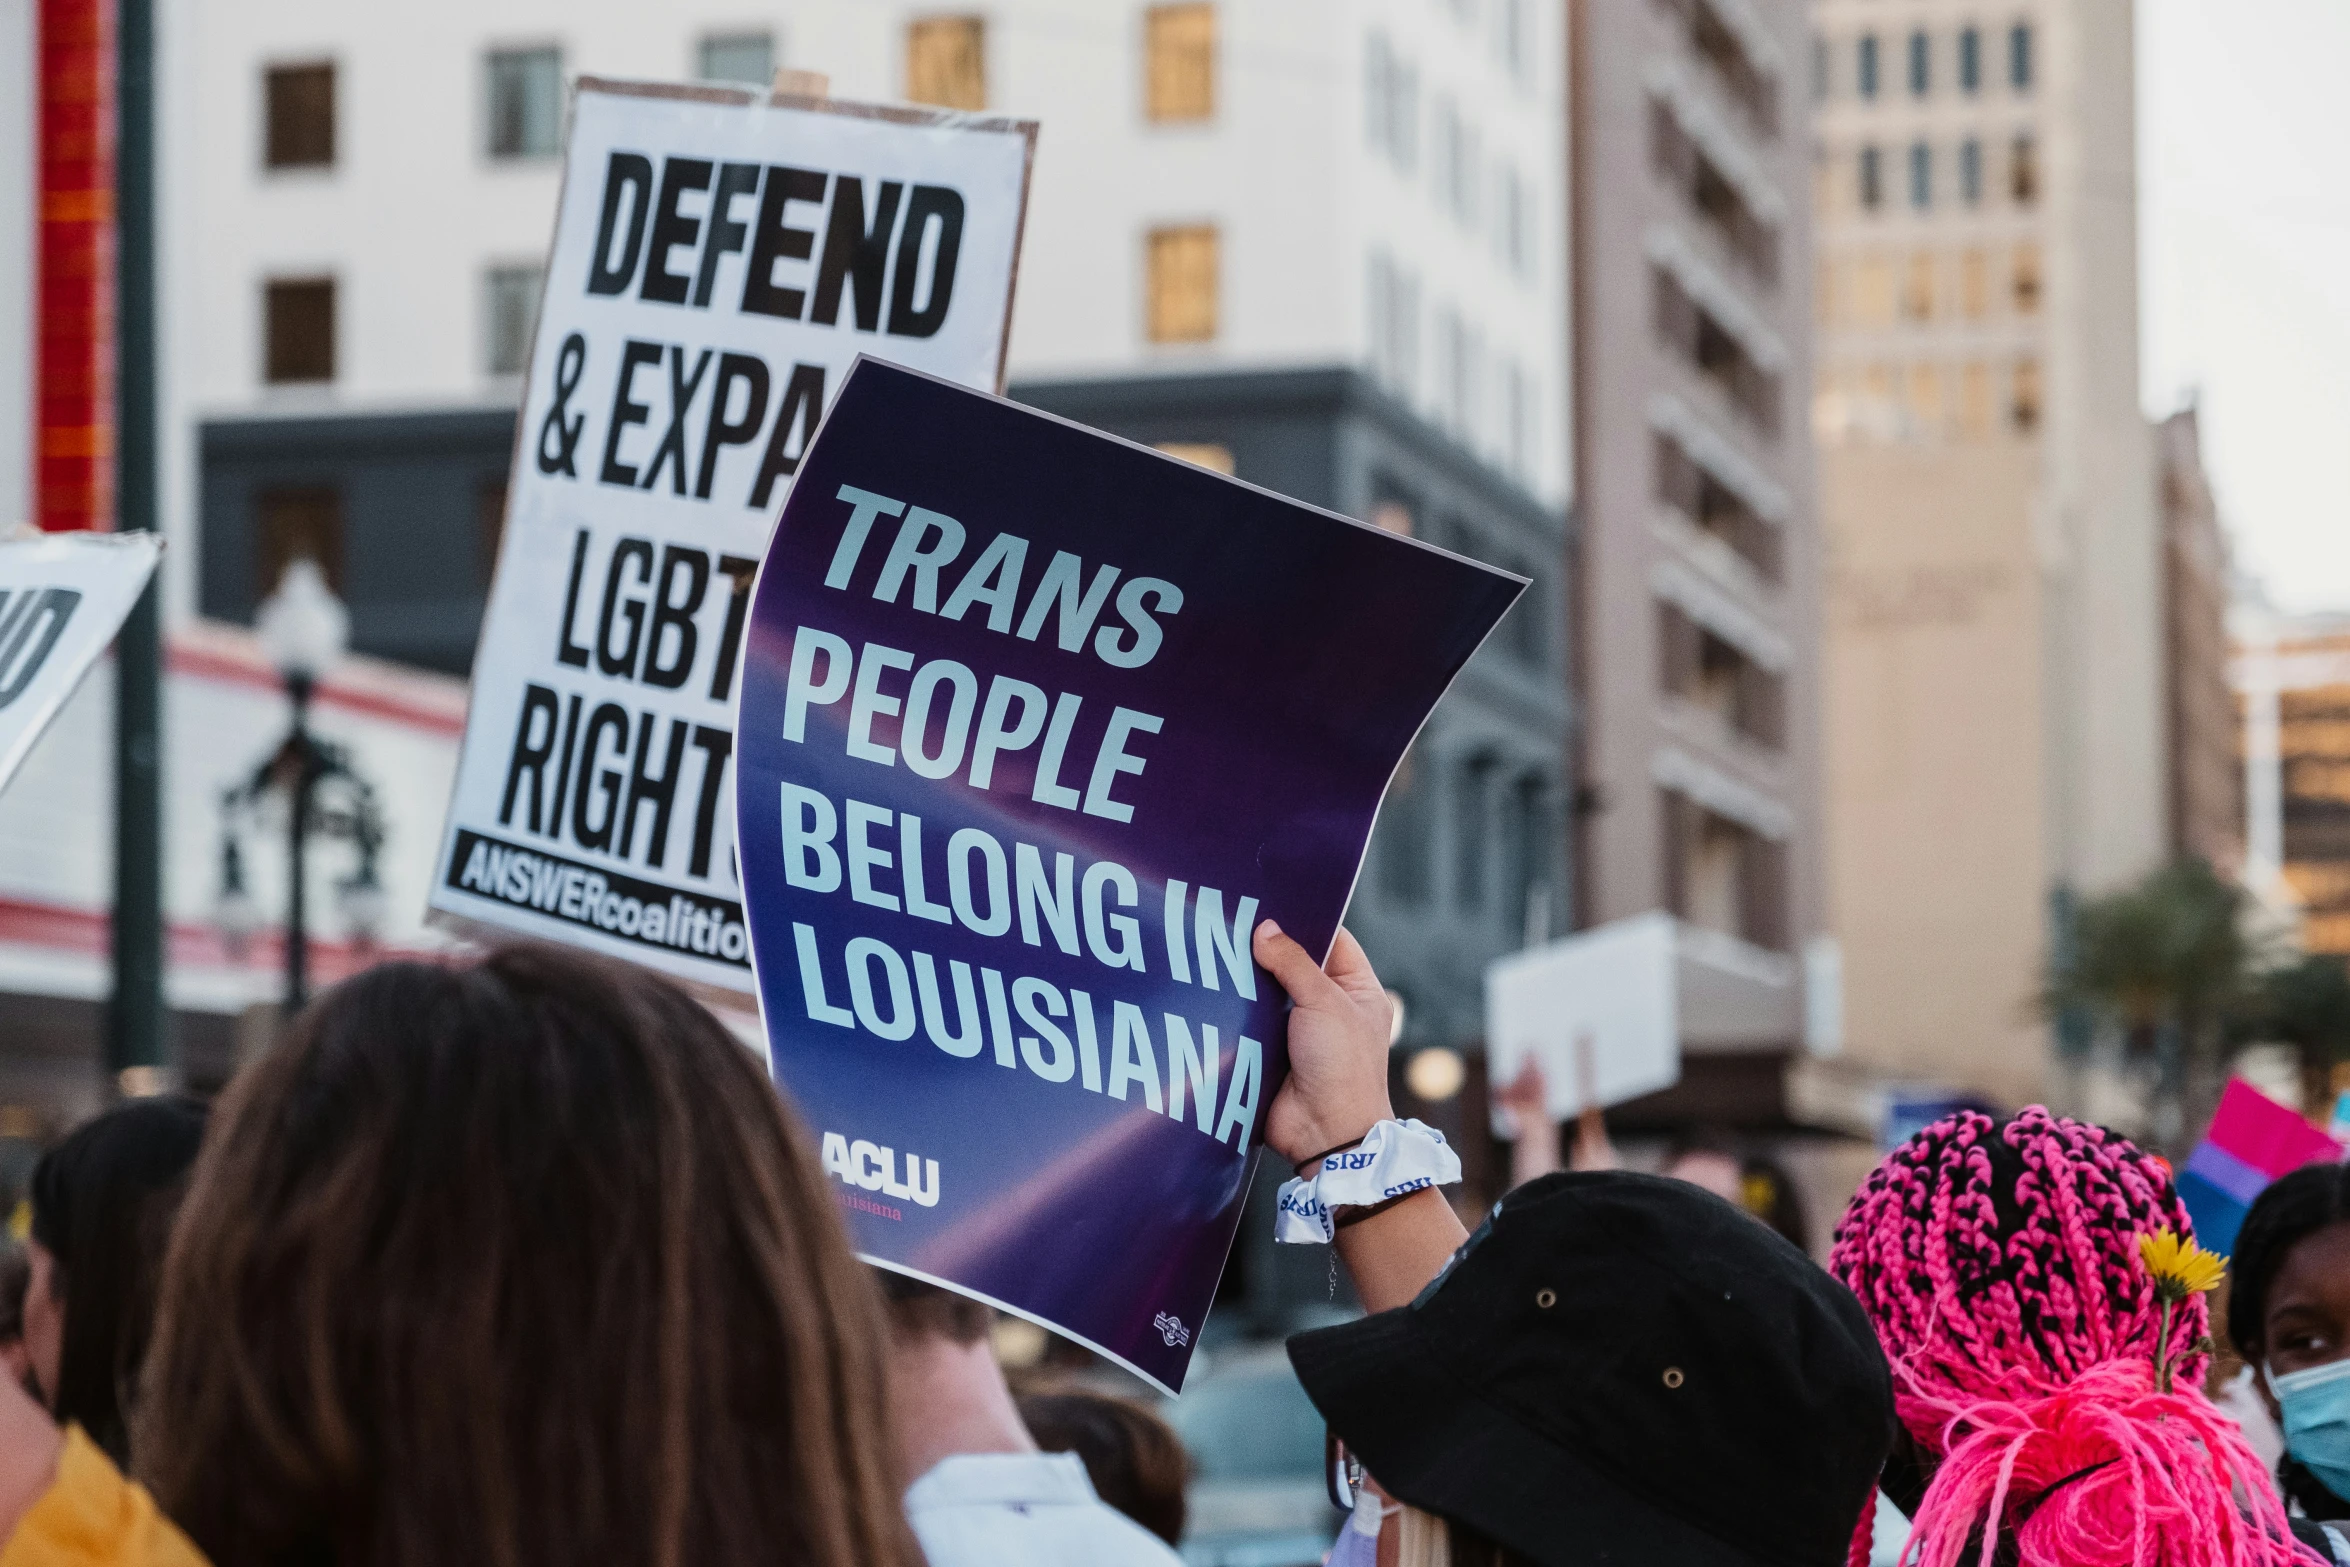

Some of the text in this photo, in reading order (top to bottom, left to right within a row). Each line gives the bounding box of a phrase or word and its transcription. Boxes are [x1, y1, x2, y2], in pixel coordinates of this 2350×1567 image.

[586, 152, 965, 338] DEFEND
[537, 332, 587, 479] &
[824, 484, 1184, 668] TRANS
[499, 682, 740, 886] RIGHT
[783, 625, 1164, 824] PEOPLE
[460, 840, 751, 963] ANSWERcoalitio
[781, 781, 1260, 1001] BELONG IN
[792, 922, 1263, 1156] LOUISIANA
[822, 1131, 939, 1207] ACLU
[1325, 1153, 1377, 1171] IRIS
